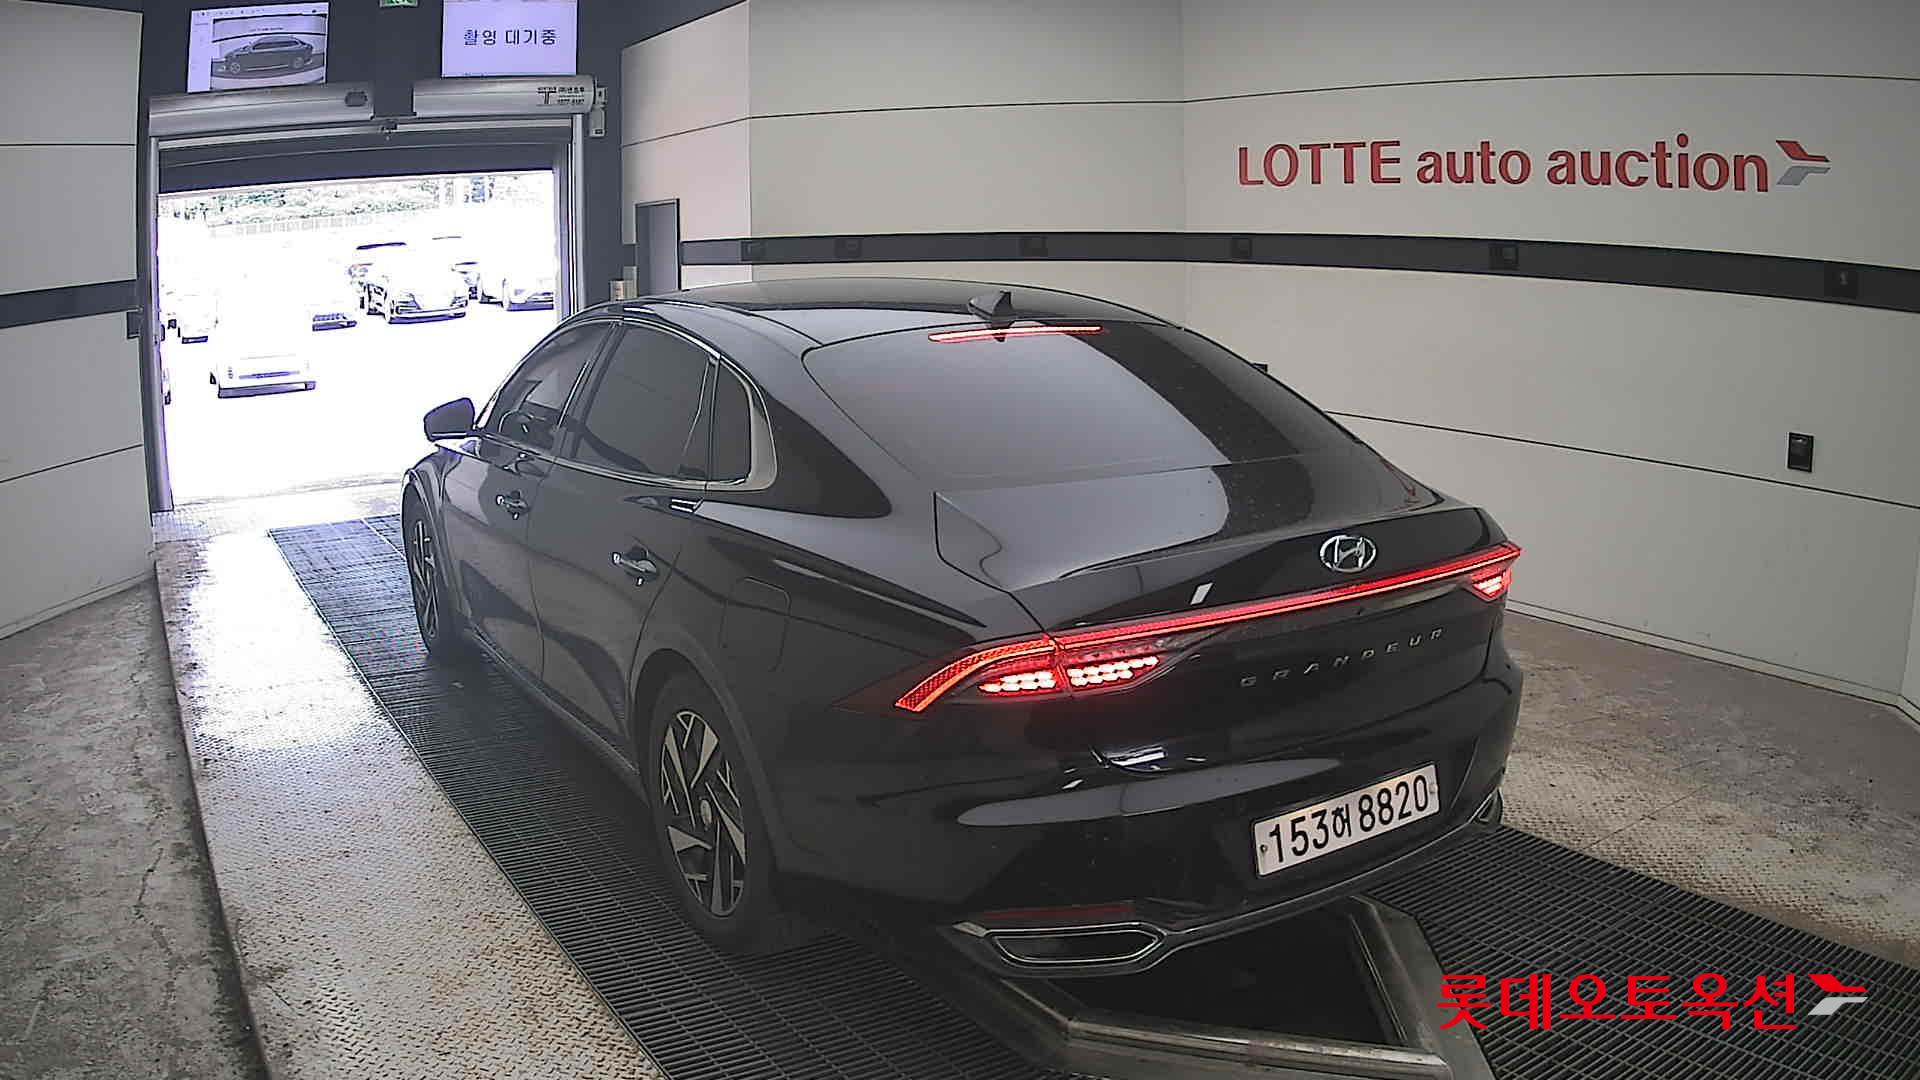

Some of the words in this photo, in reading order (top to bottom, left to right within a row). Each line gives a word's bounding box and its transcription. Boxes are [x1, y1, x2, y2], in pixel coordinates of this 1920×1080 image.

[505, 29, 558, 46] 대기중
[1239, 141, 1401, 187] LOTTE
[1416, 141, 1531, 184] auto
[1547, 133, 1768, 192] auction
[1240, 628, 1442, 687] GRANDEUR
